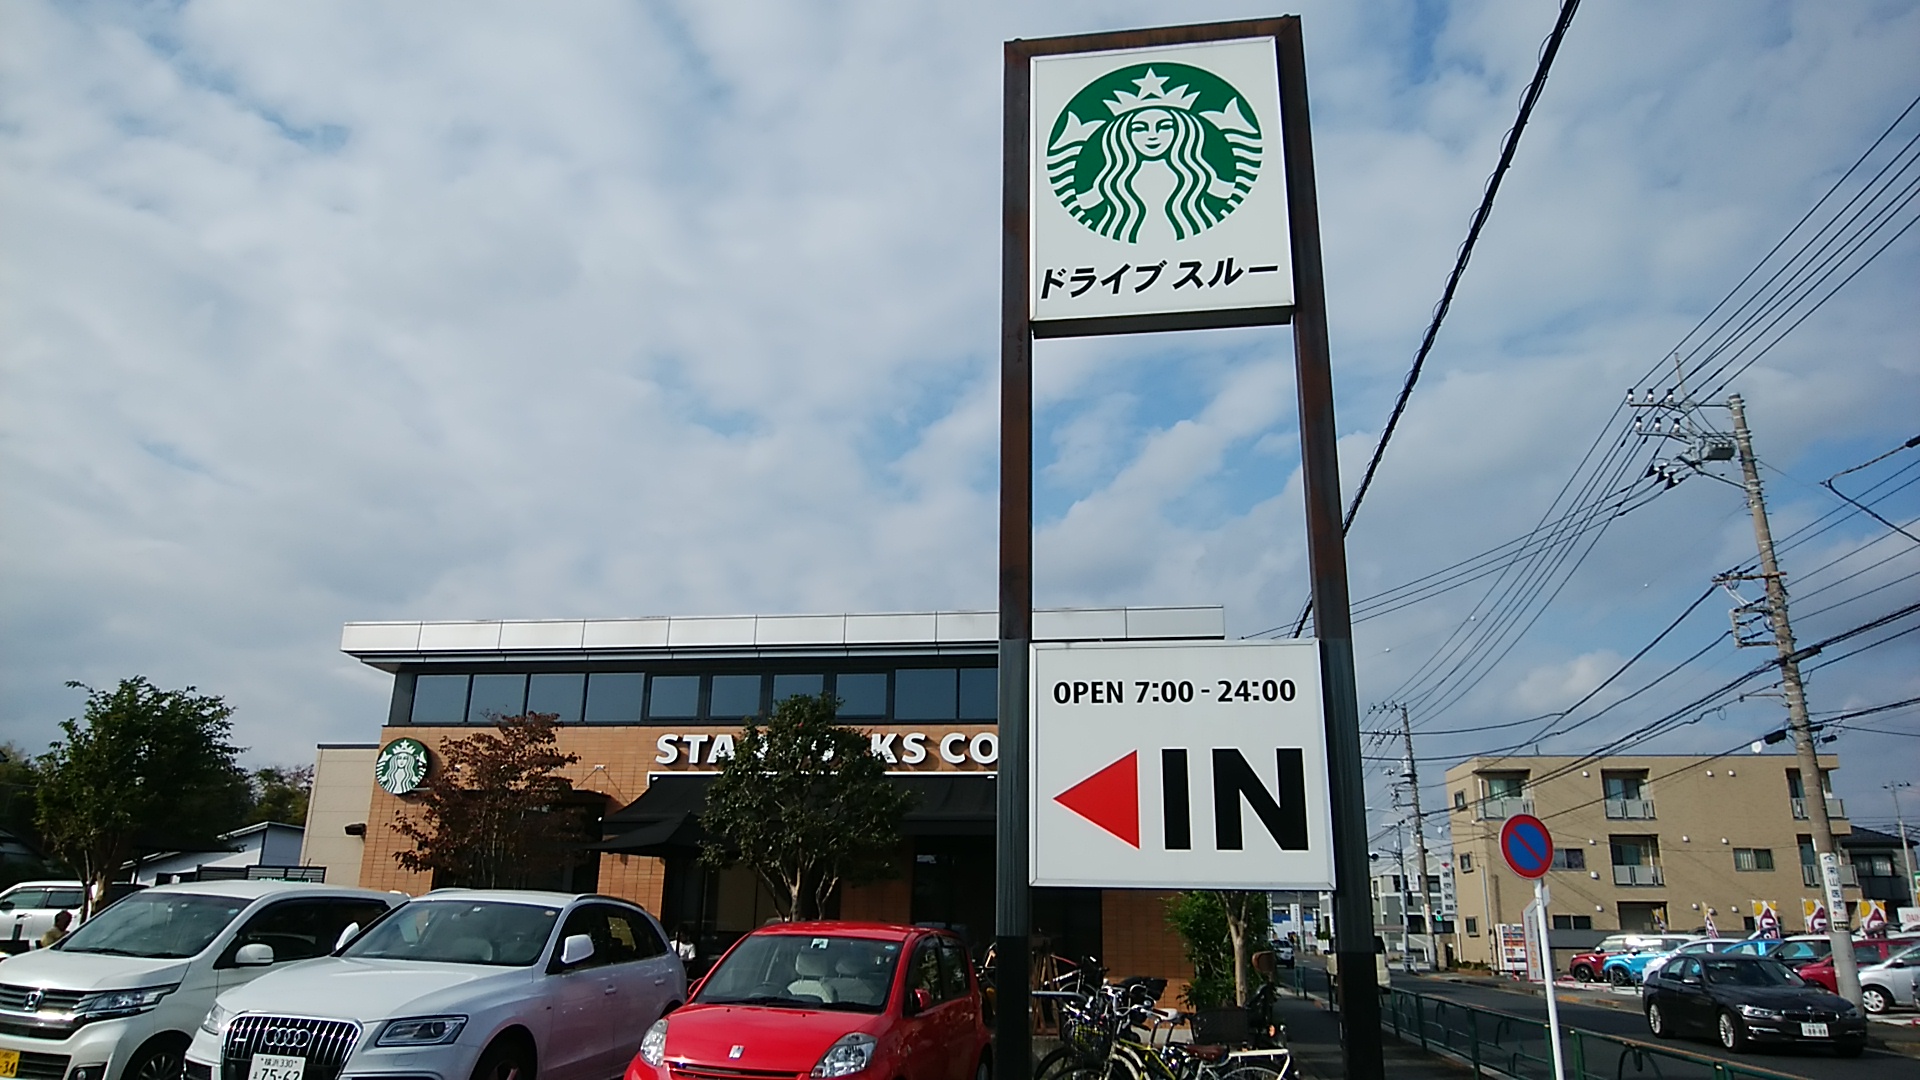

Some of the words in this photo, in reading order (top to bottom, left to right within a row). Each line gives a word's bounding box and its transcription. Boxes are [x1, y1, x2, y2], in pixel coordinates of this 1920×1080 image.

[1053, 681, 1124, 703] OPEN
[1135, 680, 1194, 703] 7:00
[1217, 679, 1297, 702] 24:00
[1160, 748, 1309, 851] IN
